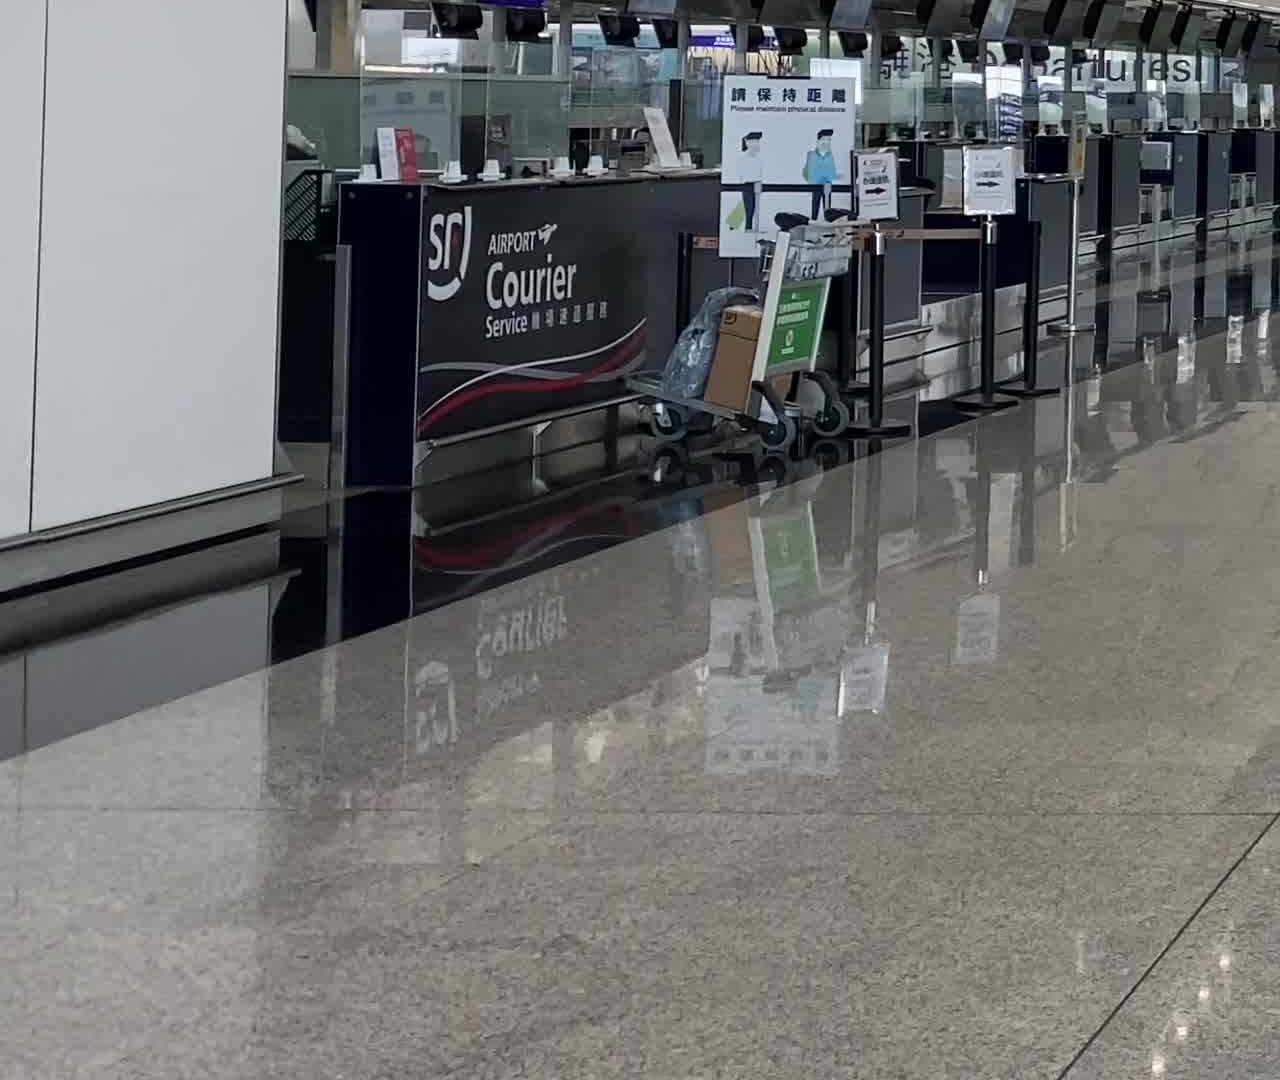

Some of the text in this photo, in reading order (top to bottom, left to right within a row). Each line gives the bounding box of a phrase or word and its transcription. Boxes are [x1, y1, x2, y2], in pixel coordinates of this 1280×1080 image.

[732, 88, 846, 103] 請保持距離
[488, 231, 537, 255] AIRPORT
[485, 253, 577, 310] Courier
[485, 311, 528, 339] Service
